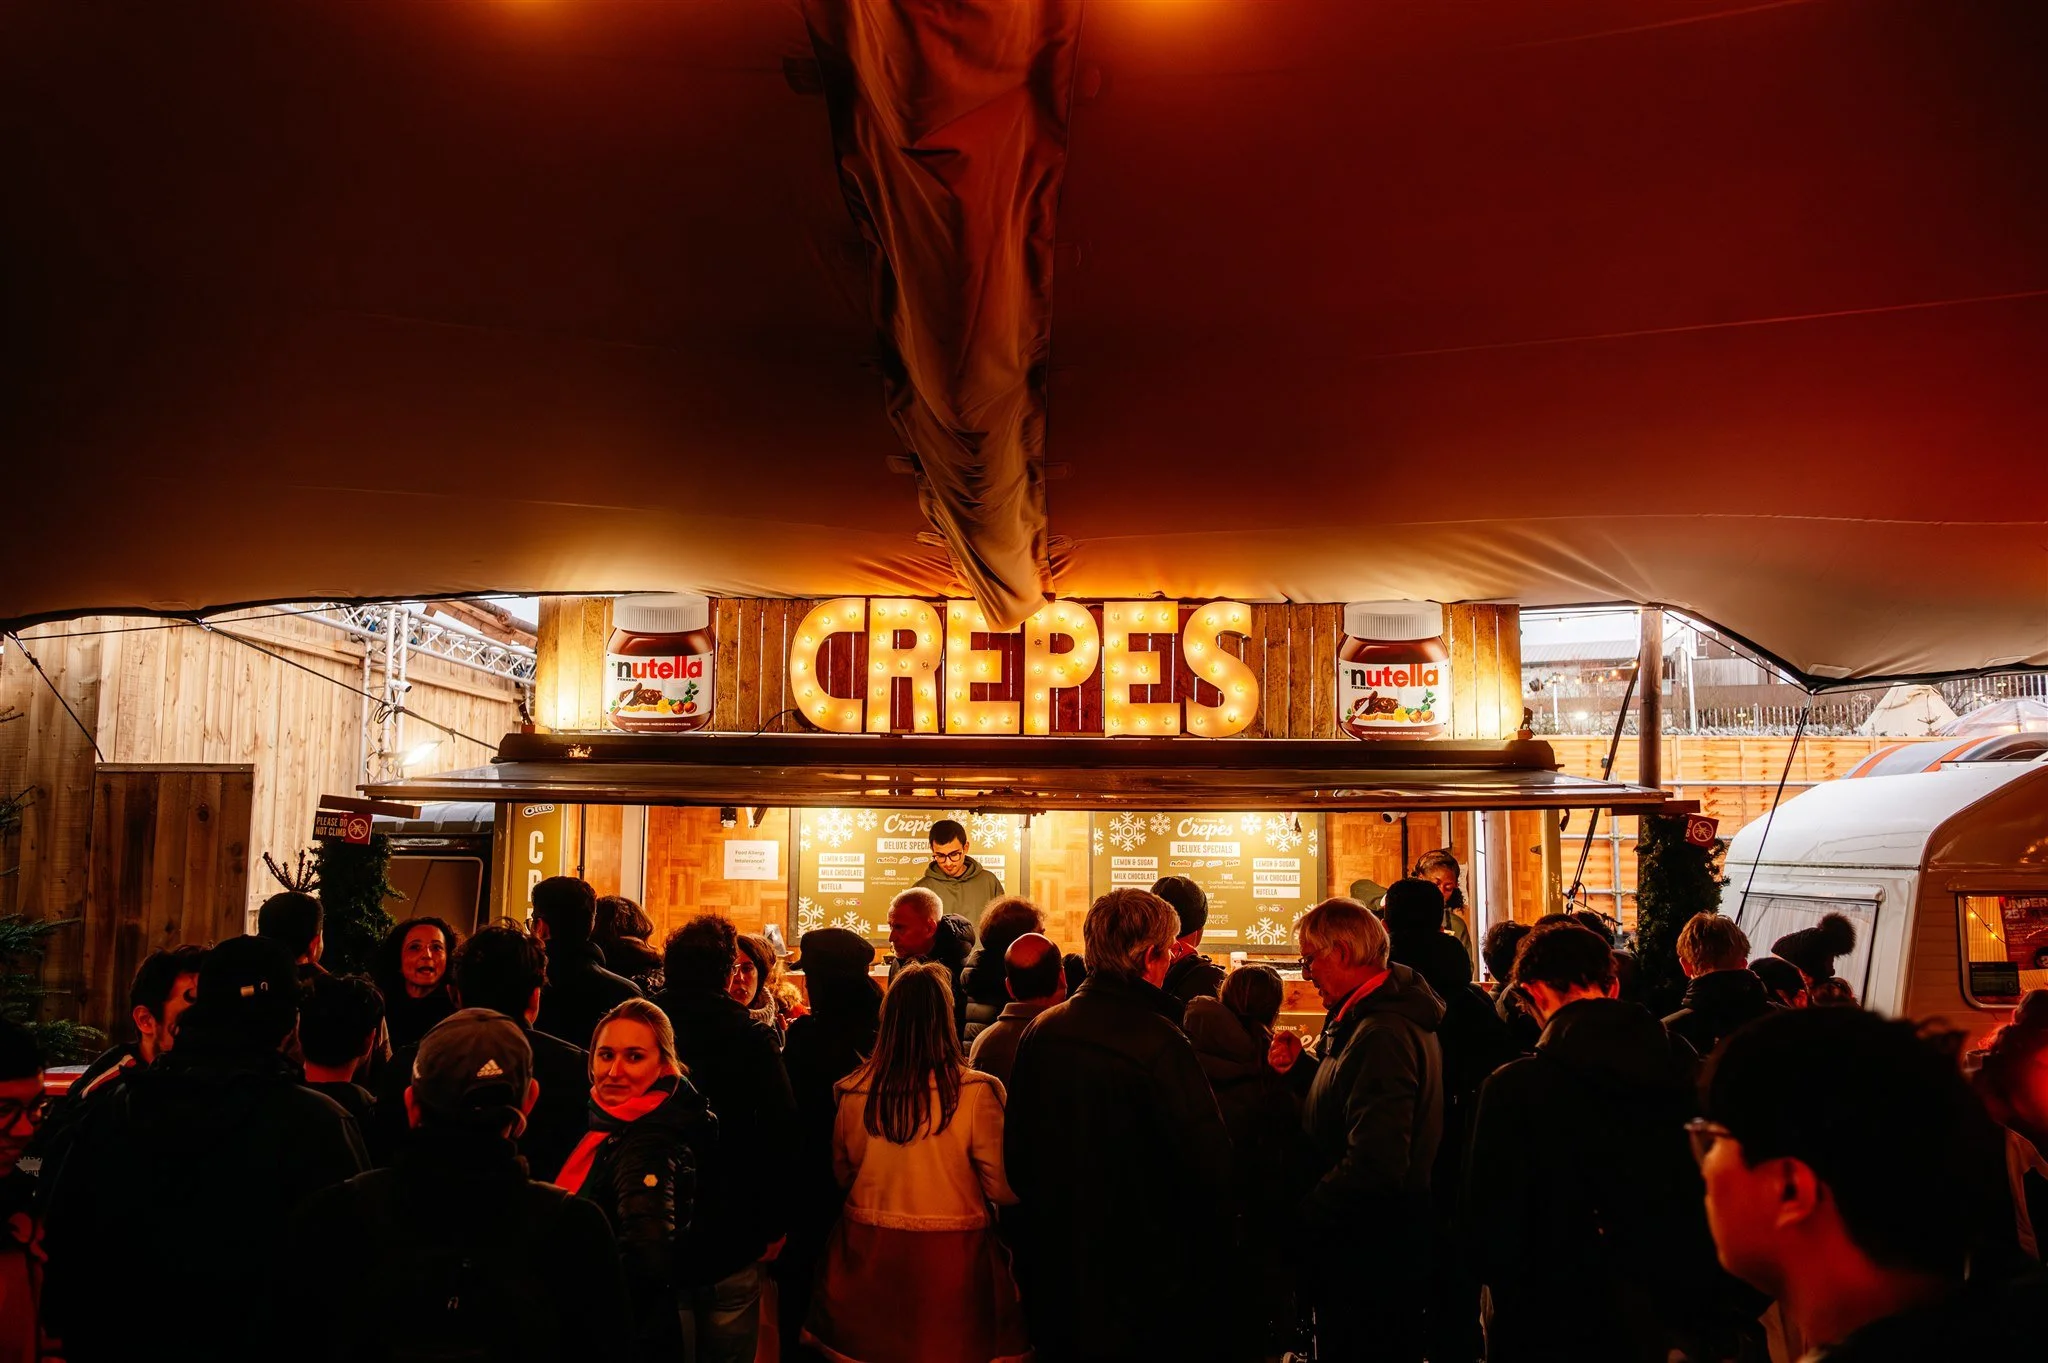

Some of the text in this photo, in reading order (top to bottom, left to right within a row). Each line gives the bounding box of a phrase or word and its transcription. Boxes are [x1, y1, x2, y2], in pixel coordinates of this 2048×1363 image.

[617, 656, 703, 679] nutella
[790, 597, 1259, 738] CREPES
[1351, 664, 1439, 688] nutella
[523, 803, 555, 817] OREO
[316, 816, 348, 828] PLEASE DO
[884, 813, 935, 837] Crepe
[315, 827, 347, 837] NOT CLIMB
[1177, 817, 1233, 840] Crepes
[884, 841, 931, 850] DELUXE SPECIA
[1177, 844, 1233, 853] DELUXE SPECIALS
[835, 869, 863, 877] CHOCOLATE
[1114, 872, 1156, 880] MILK CHOCOLATE
[1270, 874, 1298, 882] CHOCOLATE
[1255, 888, 1278, 896] NUTELLA
[2003, 897, 2048, 909] UNDER
